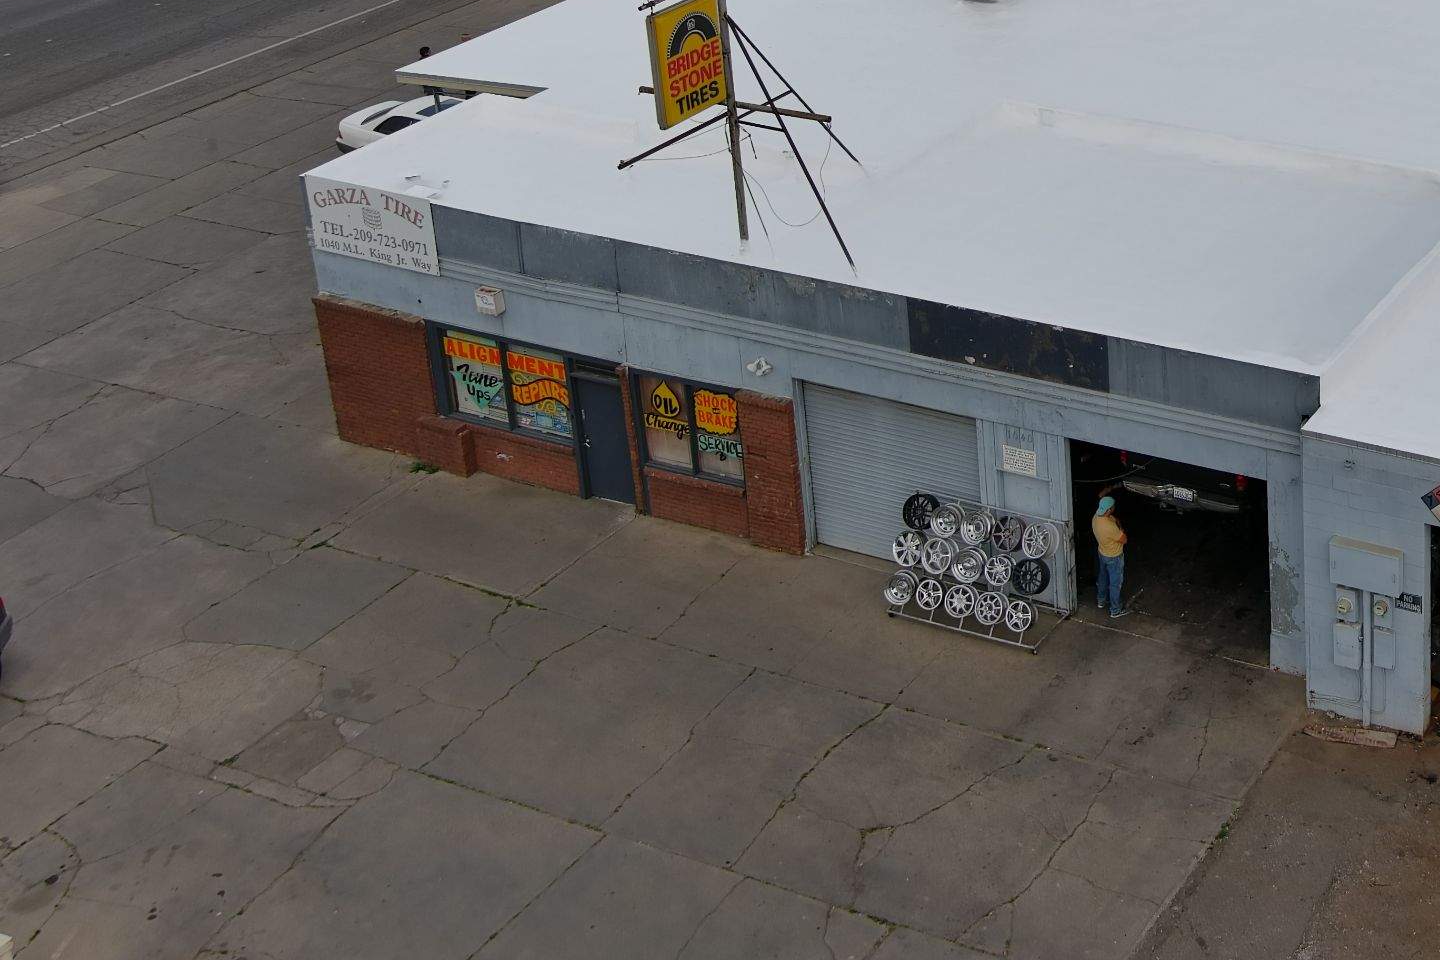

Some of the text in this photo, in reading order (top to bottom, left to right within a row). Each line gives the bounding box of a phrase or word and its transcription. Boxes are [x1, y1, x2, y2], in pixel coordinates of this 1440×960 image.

[667, 38, 721, 79] BRIDGE
[669, 59, 722, 98] STONE
[675, 80, 720, 115] TIRES
[313, 188, 424, 229] GARZA TIRE
[320, 220, 428, 256] TEL-209-723-0971
[369, 247, 393, 264] King
[412, 257, 432, 272] Way
[445, 338, 566, 381] ALIGN MENT
[456, 363, 499, 387] Tune
[512, 380, 570, 406] REPAIRS
[653, 395, 679, 415] OIL
[695, 393, 736, 413] SHOCK
[645, 412, 691, 440] Change
[697, 411, 735, 429] BRAKE
[699, 434, 744, 459] SERVICE
